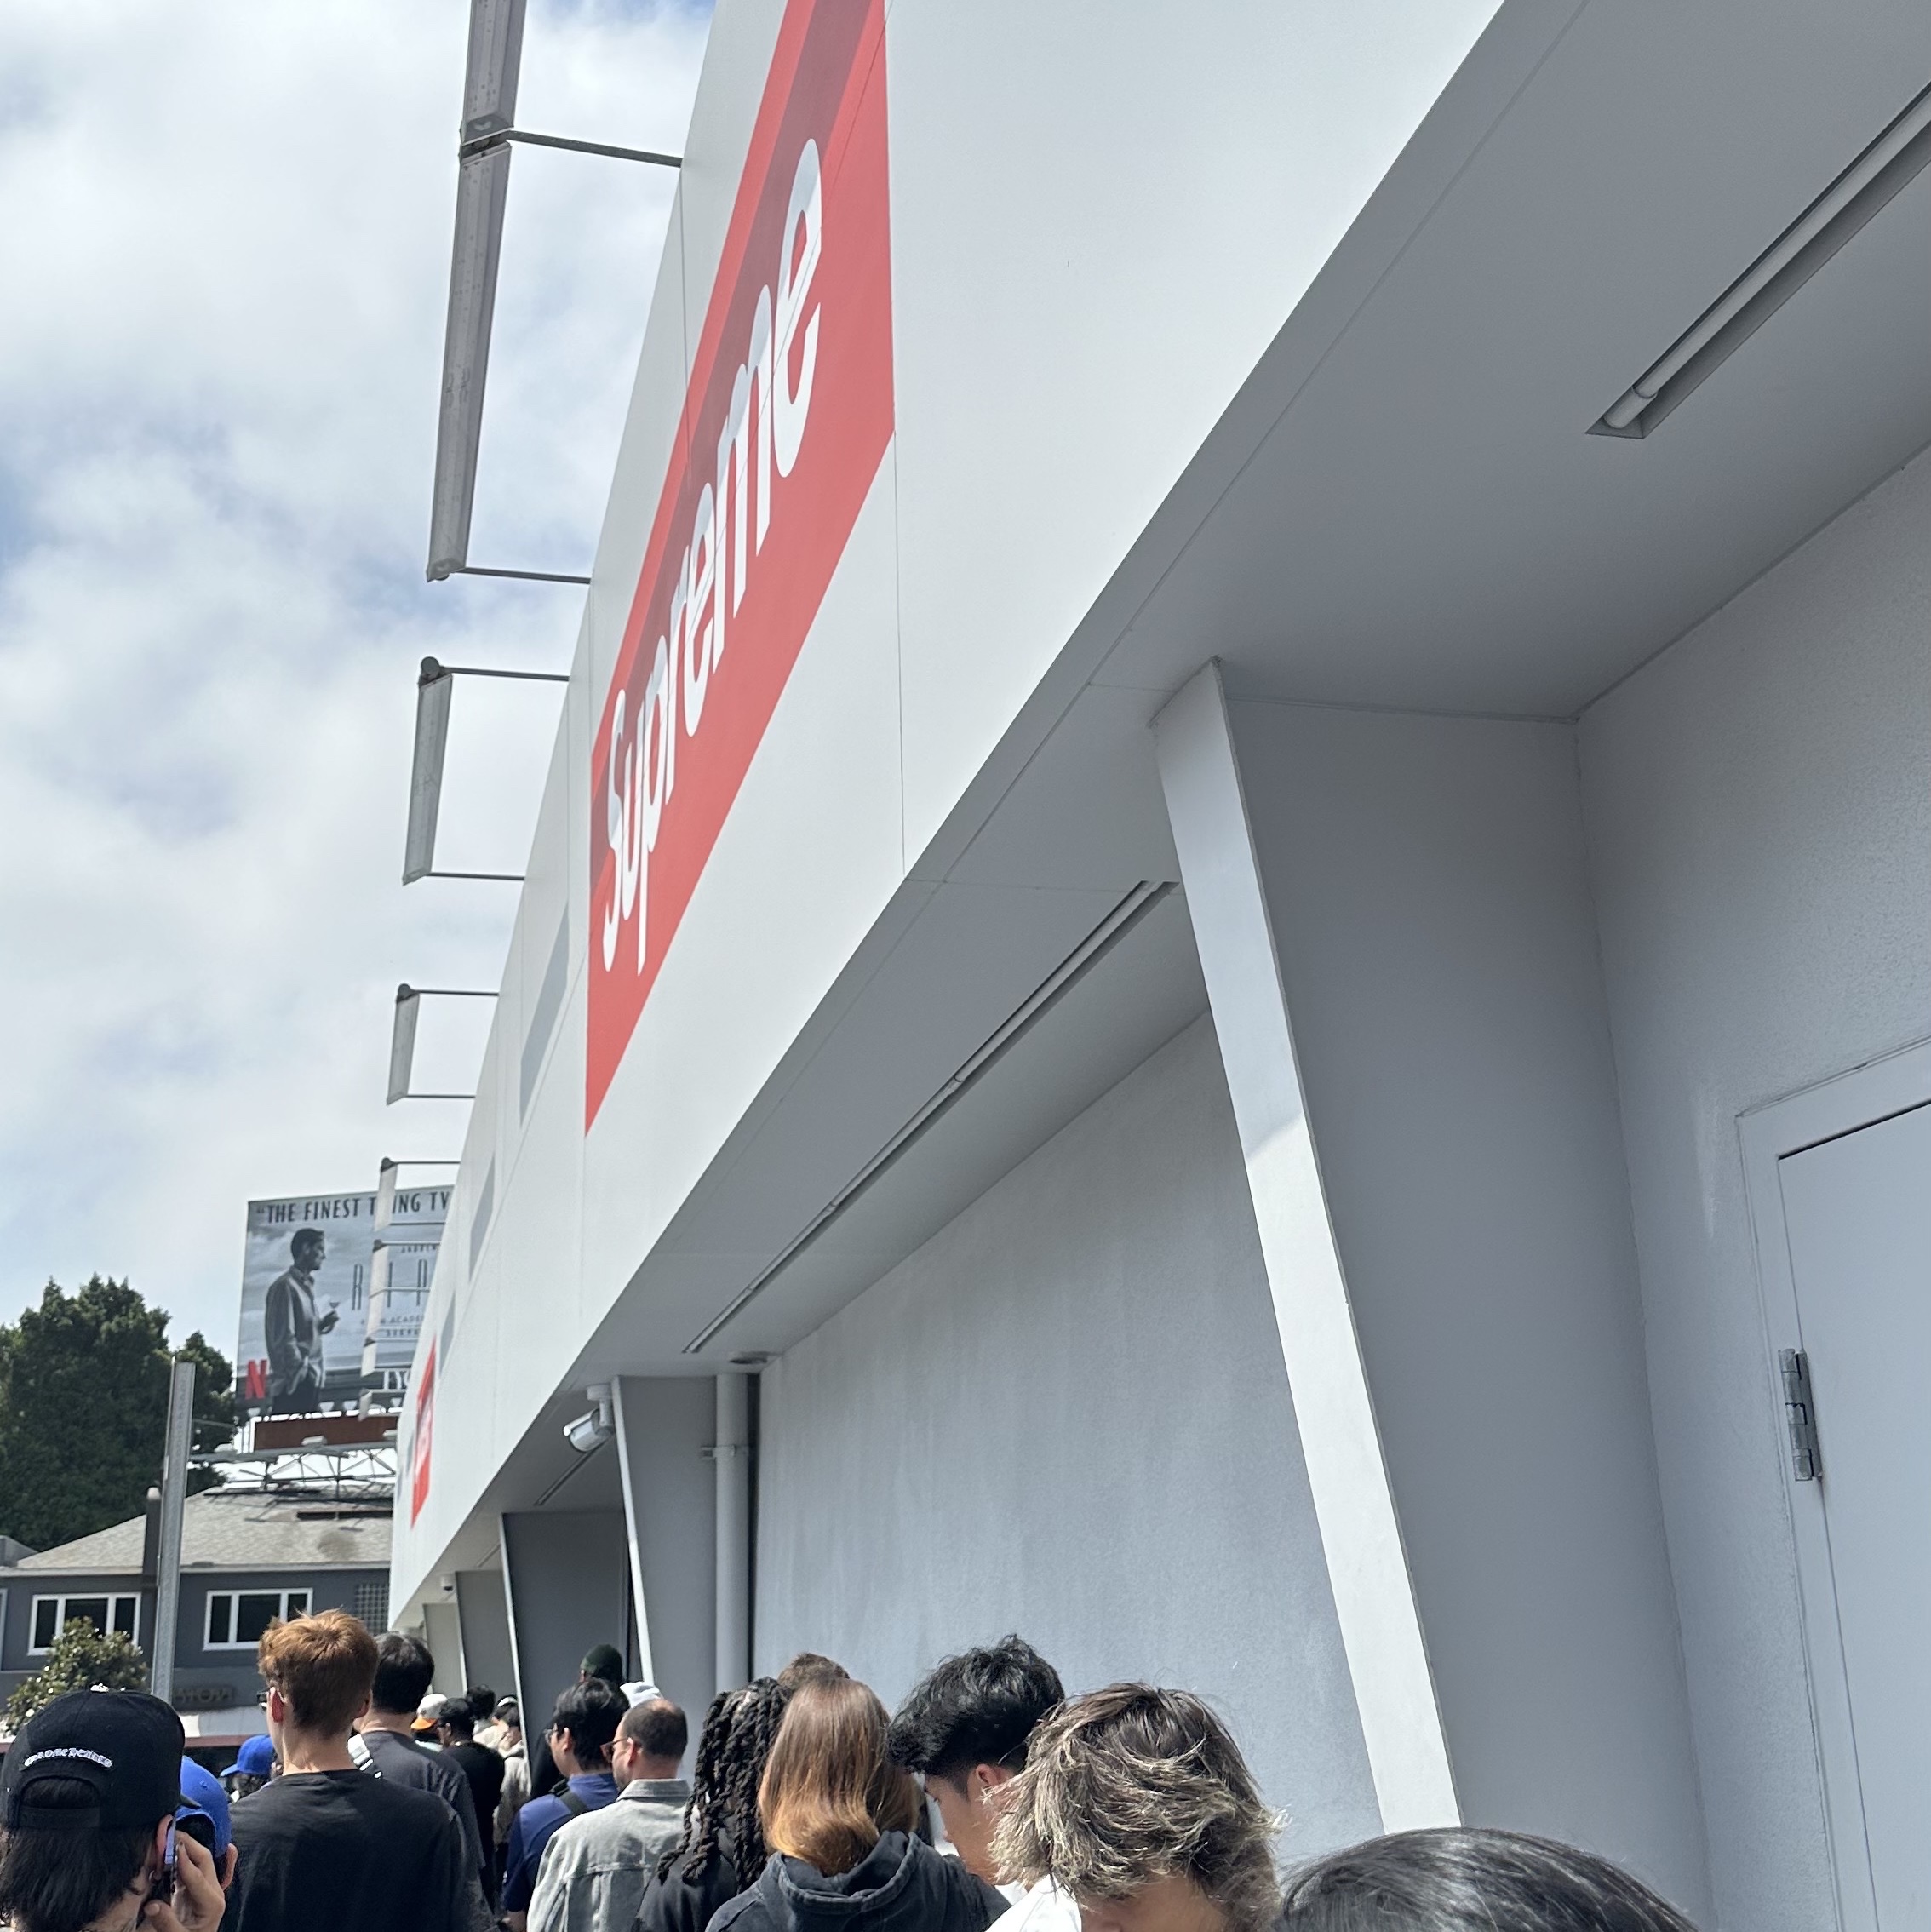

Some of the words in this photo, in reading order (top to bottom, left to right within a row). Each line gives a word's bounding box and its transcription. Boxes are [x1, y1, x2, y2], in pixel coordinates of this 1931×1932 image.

[603, 139, 822, 976] Supreme
[304, 1197, 358, 1221] FINEST
[369, 1193, 421, 1217] TING
[245, 1360, 267, 1399] N
